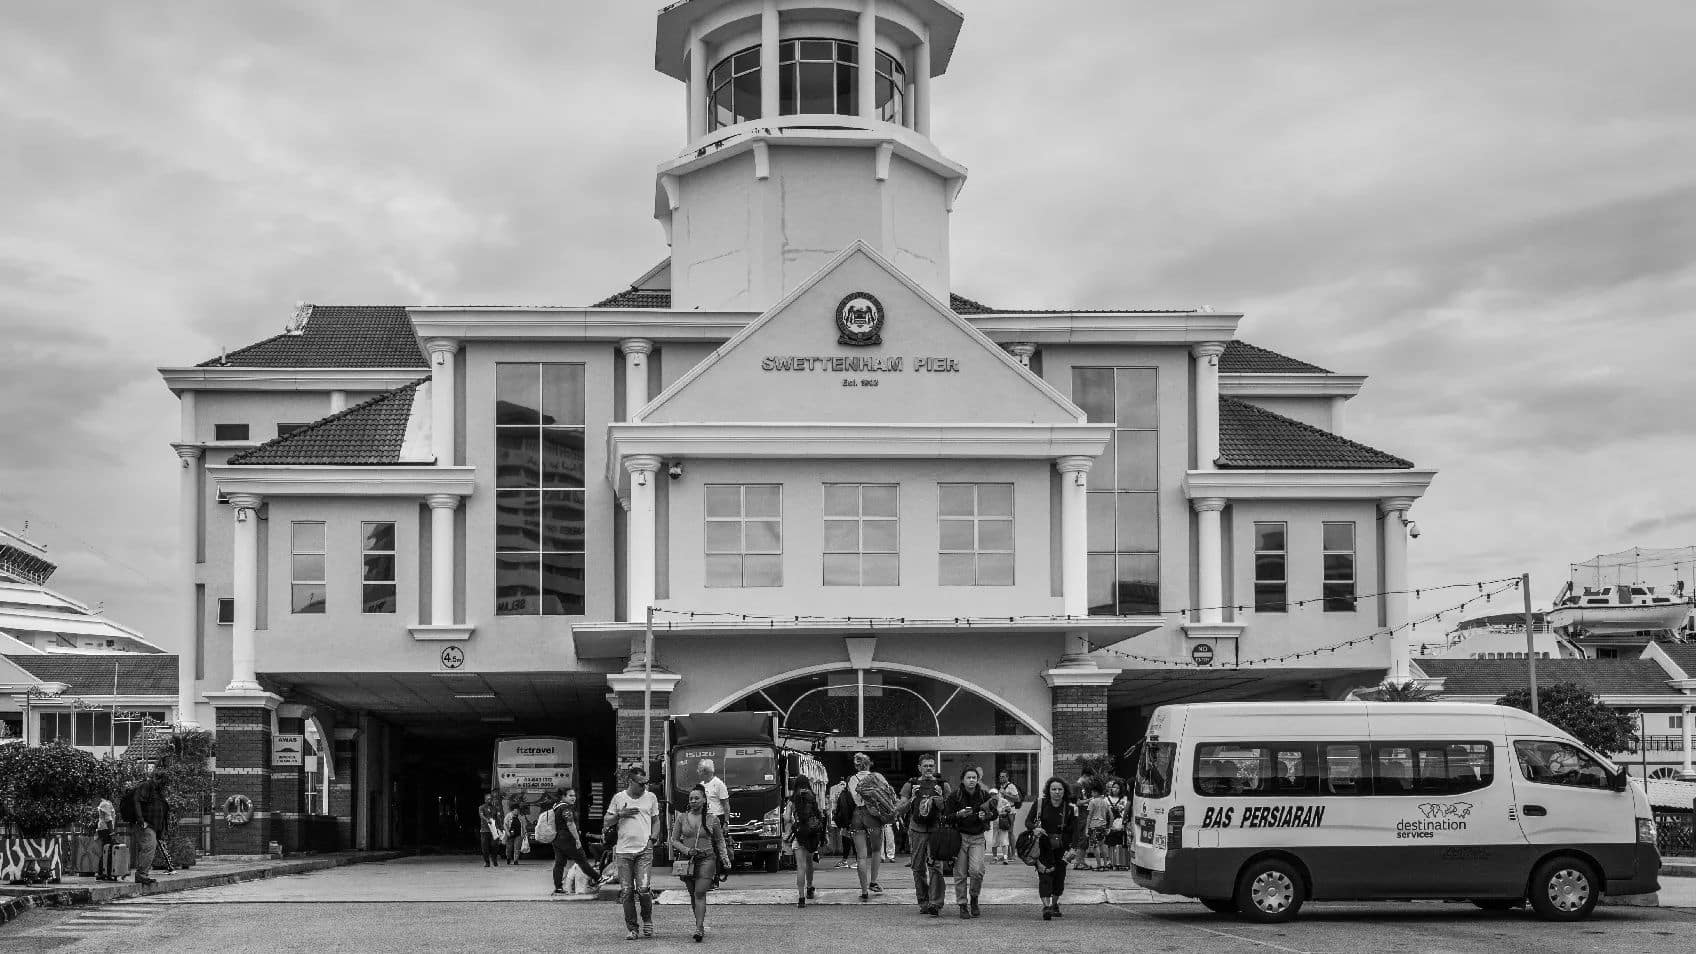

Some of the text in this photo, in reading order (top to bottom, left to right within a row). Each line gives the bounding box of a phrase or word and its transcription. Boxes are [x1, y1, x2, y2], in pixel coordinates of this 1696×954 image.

[761, 356, 960, 373] SWETTENHAM PIER
[1201, 805, 1326, 829] BAS PERSIARAN
[1396, 818, 1467, 831] destination
[1396, 831, 1434, 839] services
